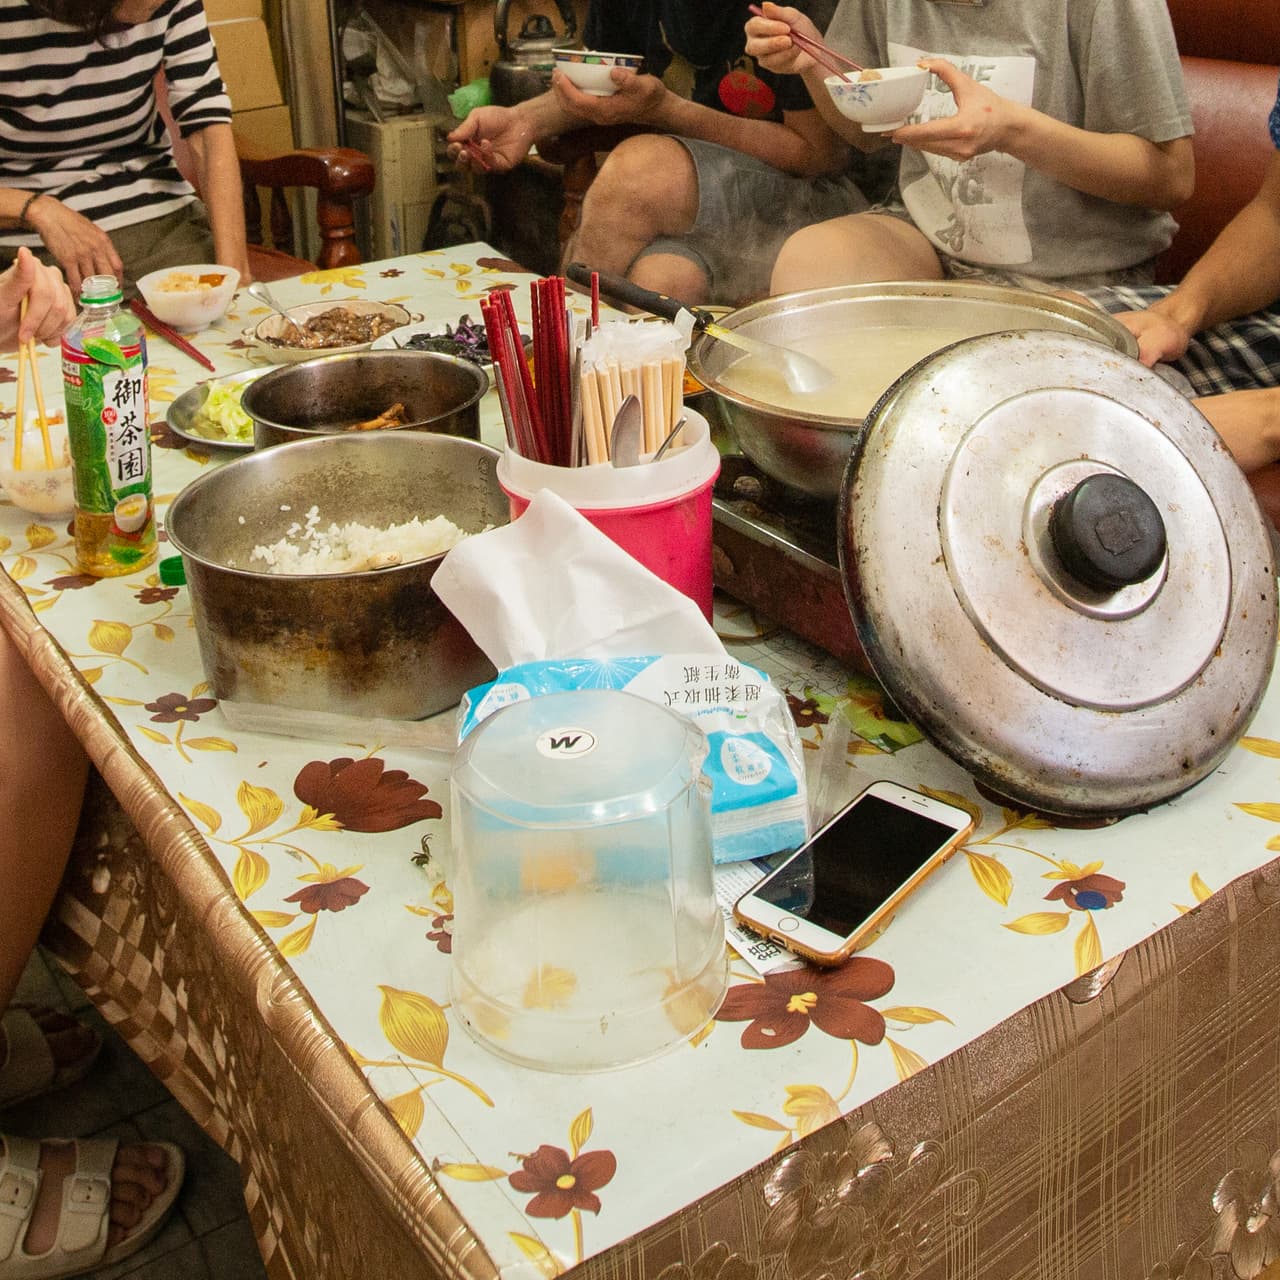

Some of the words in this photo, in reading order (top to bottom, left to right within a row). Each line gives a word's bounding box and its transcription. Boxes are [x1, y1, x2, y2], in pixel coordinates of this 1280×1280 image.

[112, 378, 144, 482] 御茶園
[683, 663, 740, 684] 衛生紙
[663, 684, 762, 707] 超柔抽取式
